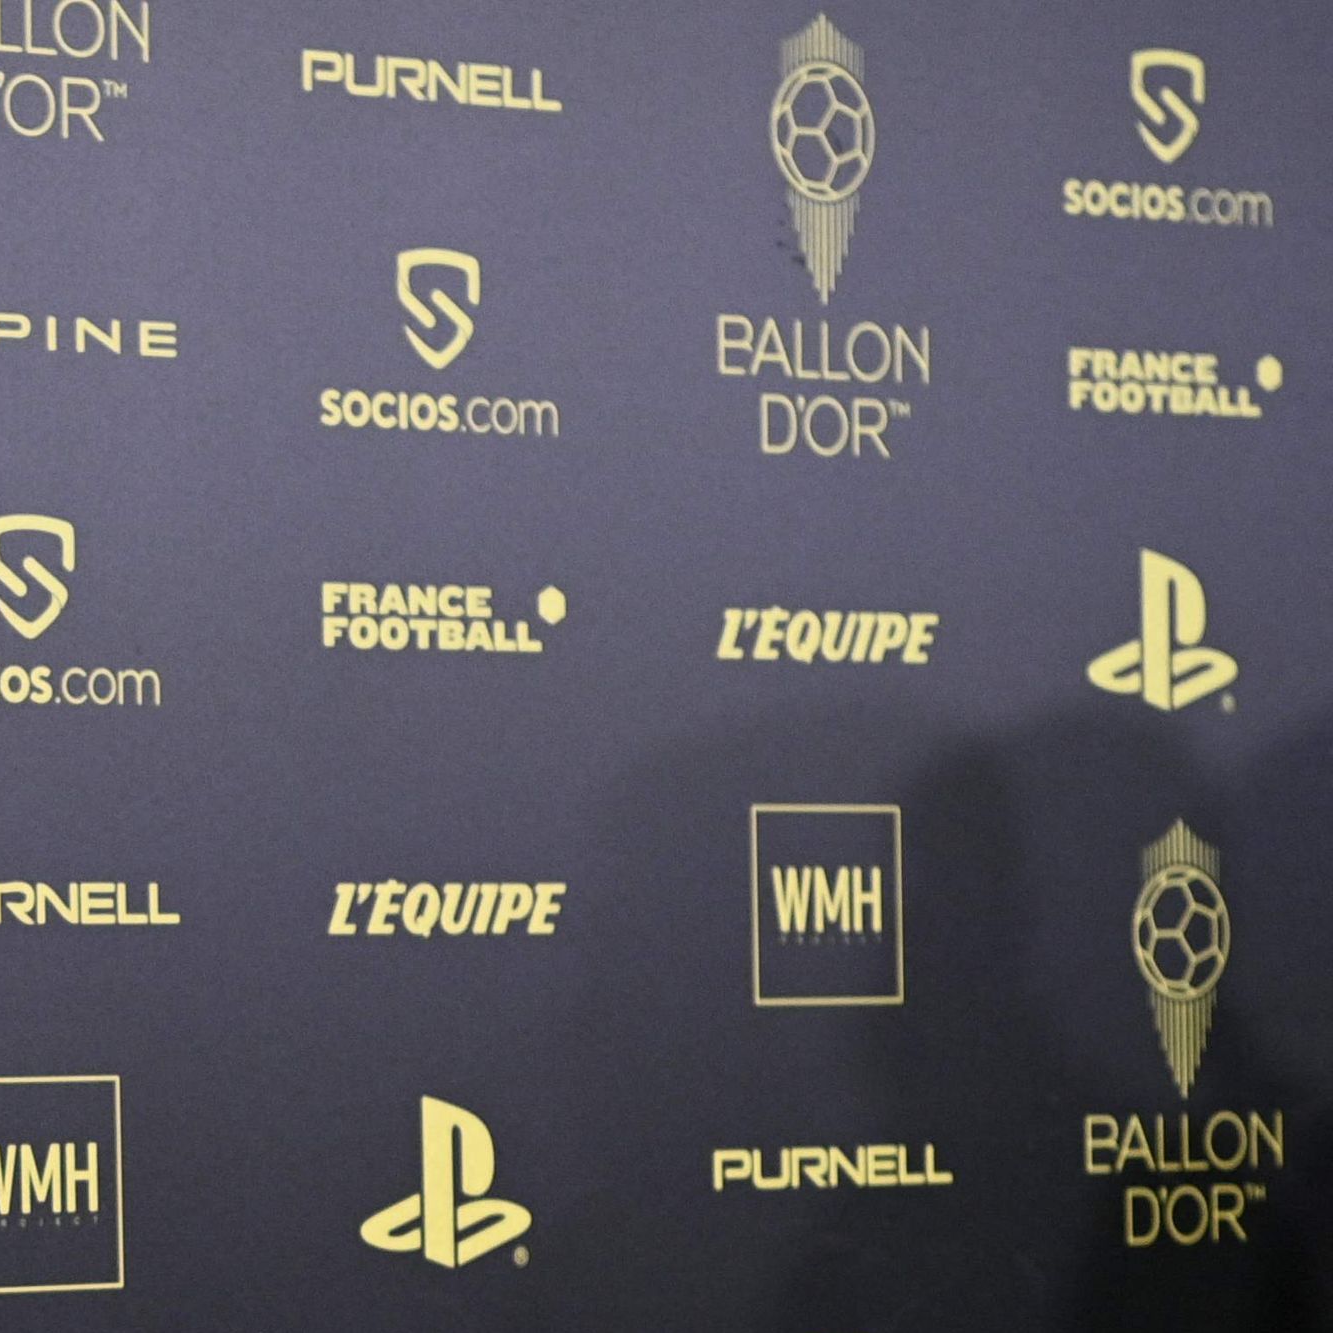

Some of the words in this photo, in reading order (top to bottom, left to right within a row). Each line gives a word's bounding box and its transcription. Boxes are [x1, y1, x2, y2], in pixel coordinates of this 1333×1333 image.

[303, 50, 561, 110] PURNELL
[1063, 180, 1273, 228] SOCIOS.com
[717, 314, 929, 383] BALLON
[1069, 348, 1217, 383] FRANCE
[321, 390, 558, 434] SOCIOS.com
[1069, 382, 1262, 417] FOOTBALL
[322, 582, 491, 618] FRANCE
[323, 617, 542, 652] FOOTBALL
[717, 606, 938, 663] L'ÉQUIPE
[328, 879, 566, 937] L'ÉQUIPE
[774, 868, 880, 931] WMH
[714, 1145, 952, 1189] PURNELL
[1085, 1112, 1282, 1174] BALLON
